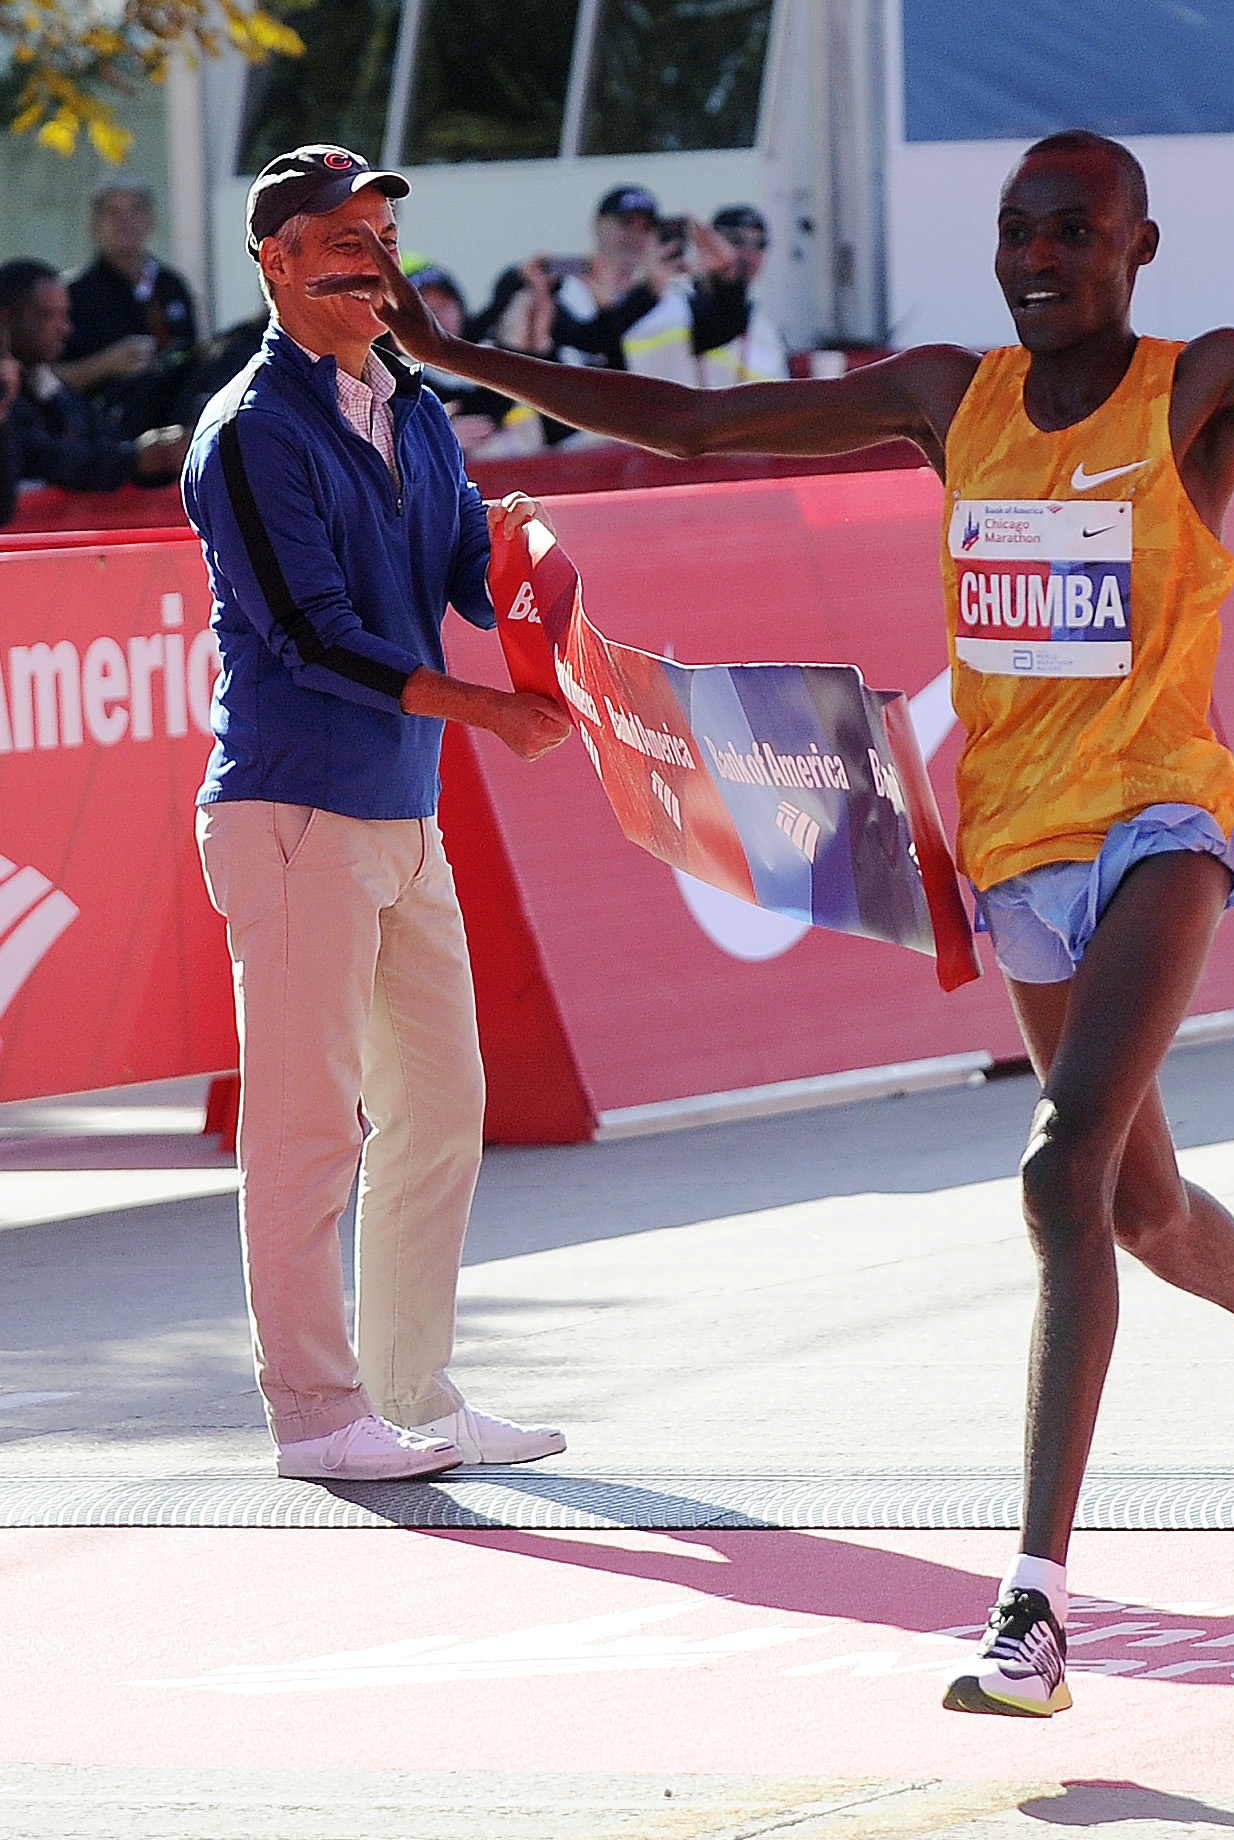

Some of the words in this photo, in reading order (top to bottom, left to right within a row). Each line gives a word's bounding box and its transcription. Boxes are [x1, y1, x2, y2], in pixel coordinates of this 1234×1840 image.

[985, 518, 1030, 532] Chicago
[985, 532, 1041, 543] Marathon
[507, 581, 541, 624] Ba
[960, 571, 1126, 628] CHUMBA
[0, 592, 222, 753] meric
[633, 713, 696, 770] America
[703, 735, 756, 785] Bank
[745, 740, 773, 787] of
[762, 741, 851, 790] America
